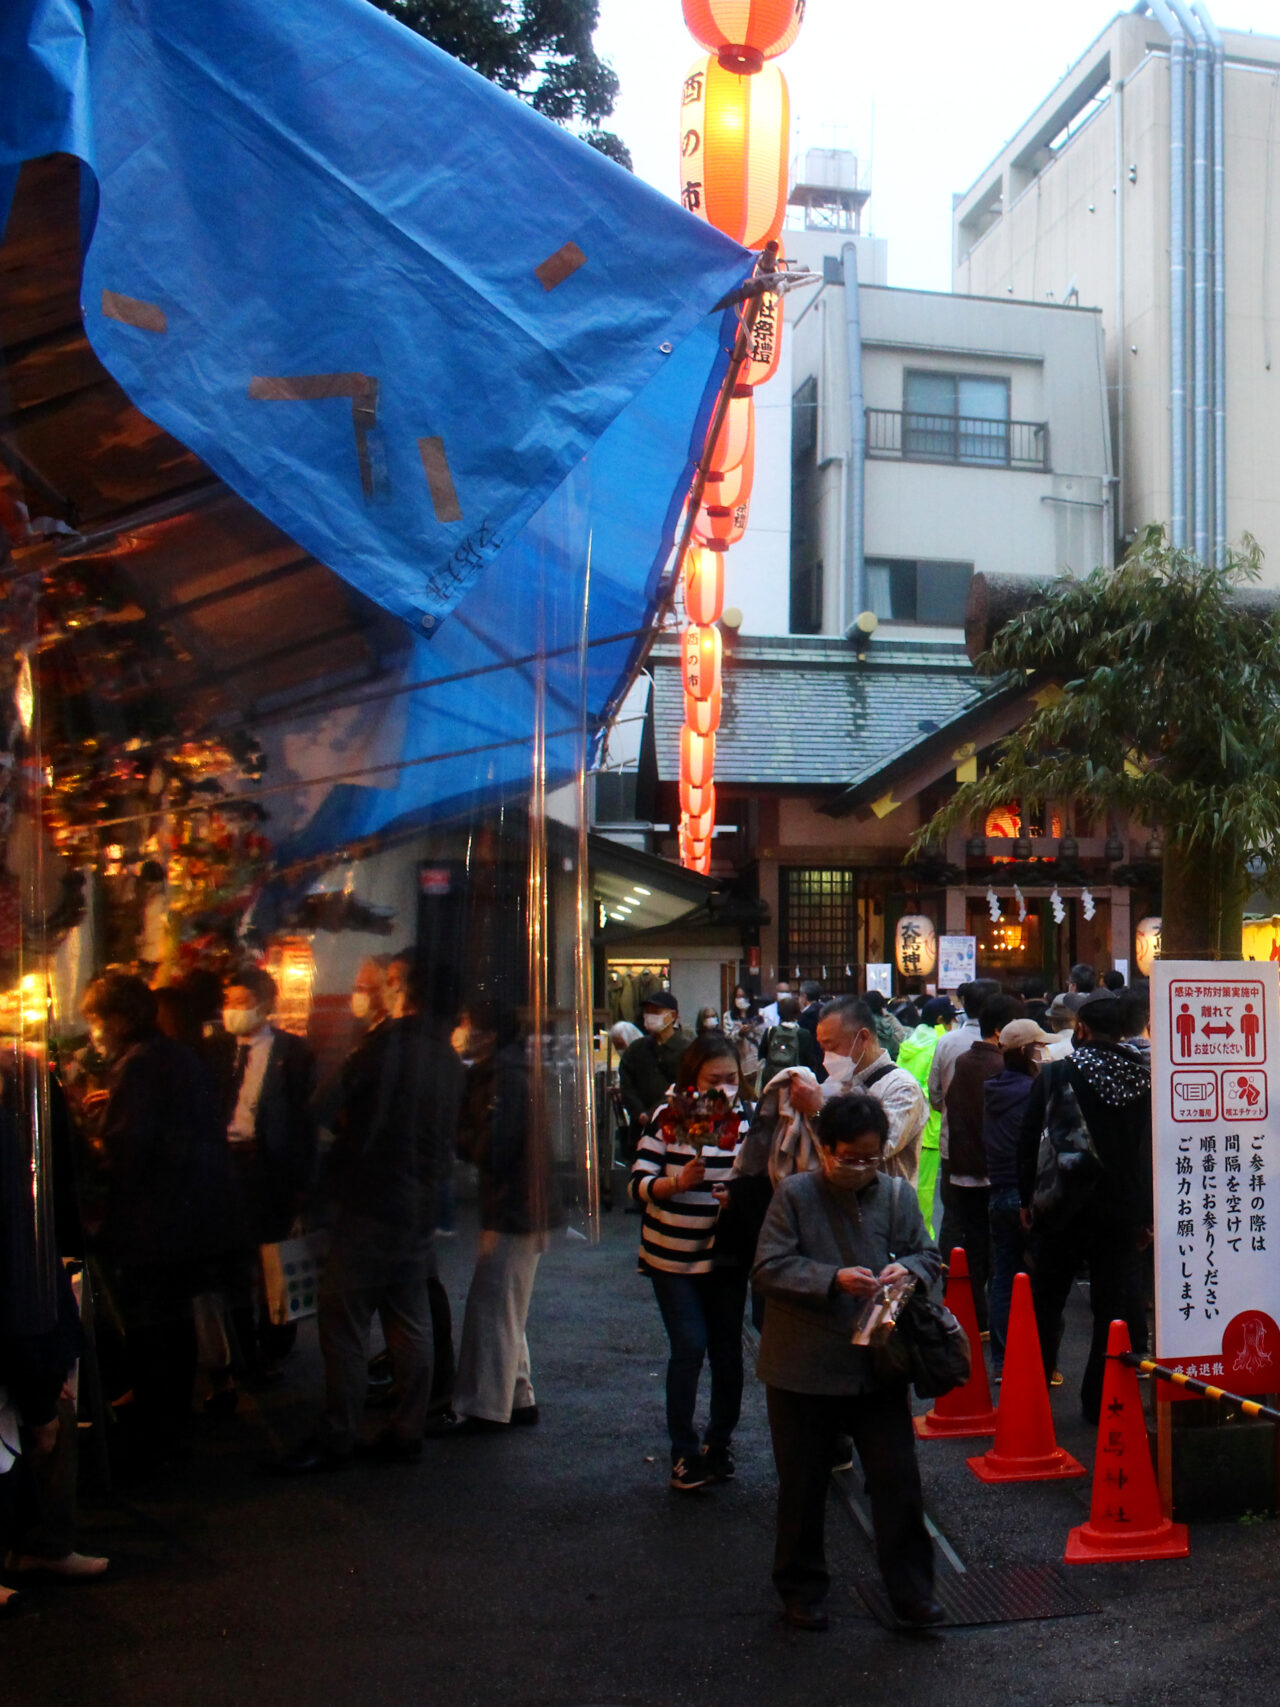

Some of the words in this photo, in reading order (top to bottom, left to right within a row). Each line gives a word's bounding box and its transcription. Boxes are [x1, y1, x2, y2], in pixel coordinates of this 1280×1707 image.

[681, 71, 703, 212] 酉の市
[686, 632, 699, 687] 酉の市
[901, 921, 921, 975] 大鳥神社
[1174, 986, 1260, 998] 感染予防対策実施中
[1201, 1005, 1233, 1018] 離れて
[1194, 1043, 1244, 1055] お並びください
[1179, 1108, 1212, 1118] マスク着用
[1224, 1134, 1243, 1253] 間隔を空けて
[1249, 1134, 1267, 1252] ご参拝の際は
[1175, 1136, 1195, 1321] ご協力お願いします
[1199, 1135, 1220, 1320] 順番にお参りください
[1172, 1362, 1225, 1378] 疫病退散
